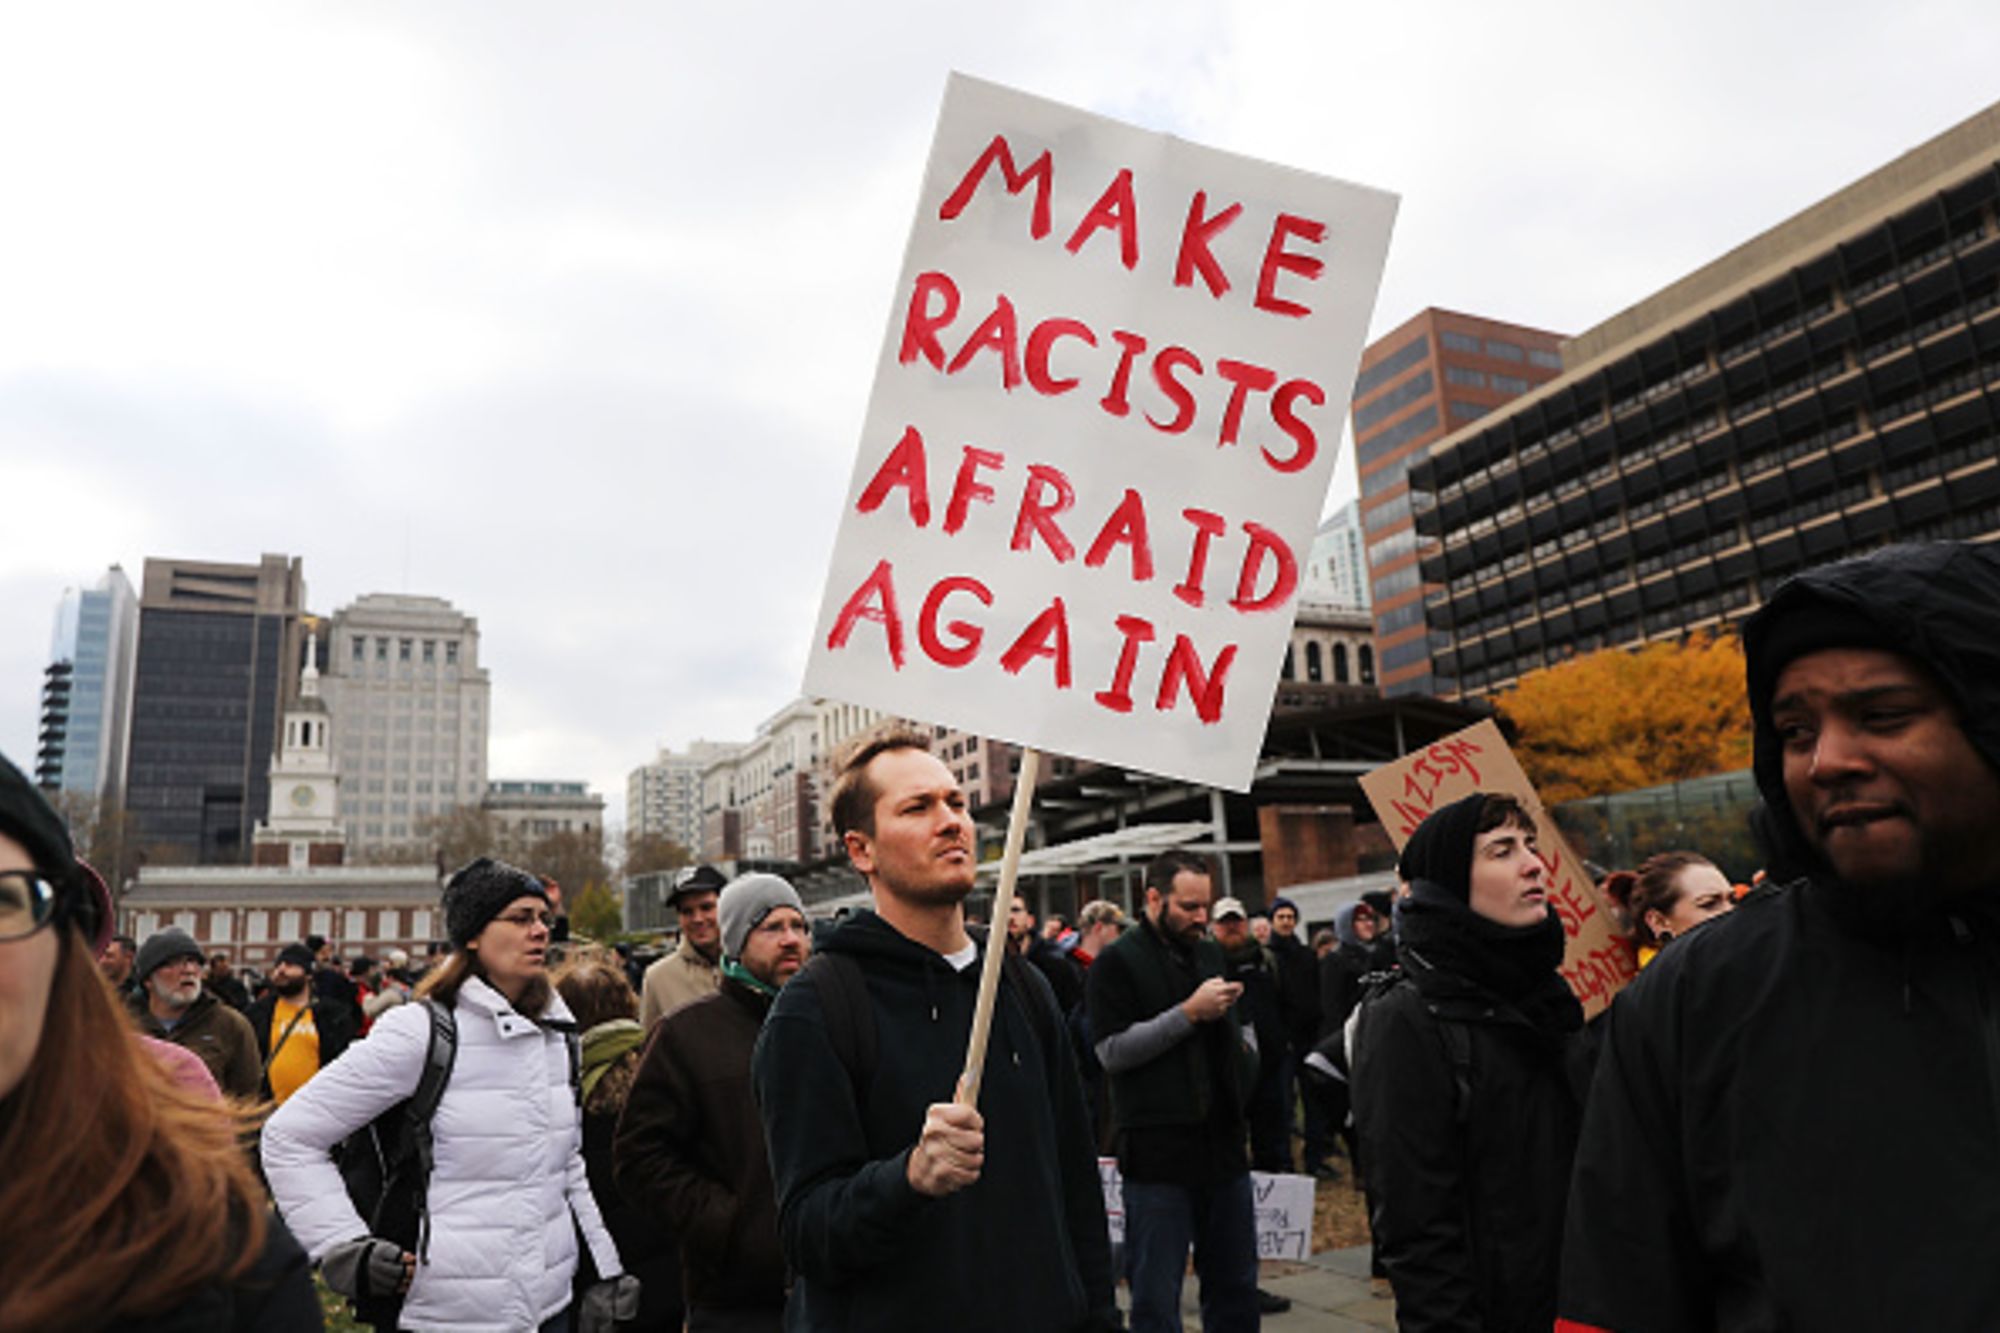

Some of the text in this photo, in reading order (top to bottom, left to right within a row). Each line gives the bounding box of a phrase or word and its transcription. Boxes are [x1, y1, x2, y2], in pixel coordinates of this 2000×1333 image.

[939, 135, 1328, 319] MAKE
[898, 271, 1326, 475] RACISTS
[855, 425, 1299, 615] AFRAID
[826, 559, 1239, 725] AGAIN
